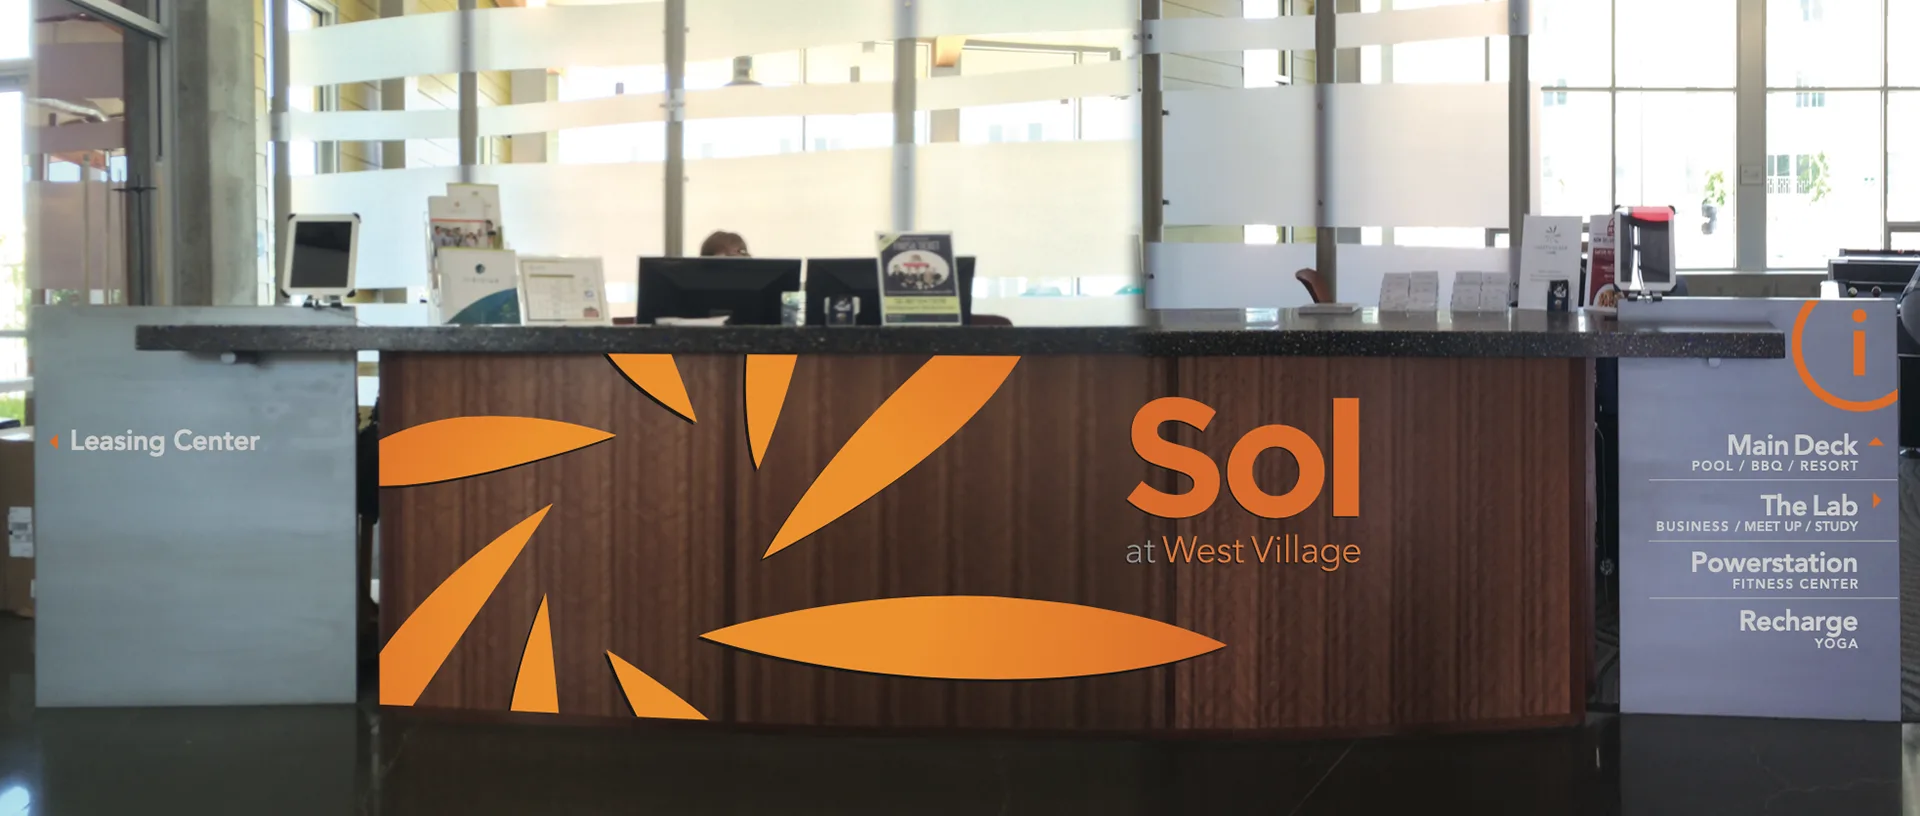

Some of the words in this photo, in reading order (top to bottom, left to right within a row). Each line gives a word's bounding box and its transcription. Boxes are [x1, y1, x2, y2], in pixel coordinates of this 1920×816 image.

[71, 429, 166, 457] Leasing
[174, 429, 261, 452] Center
[1728, 434, 1789, 455] Main
[1795, 433, 1859, 455] Deck
[1127, 397, 1360, 518] Sol
[1692, 460, 1734, 472] POOL
[1752, 460, 1783, 473] BBQ
[1801, 460, 1859, 472] RESORT
[1760, 493, 1808, 516] The
[1814, 493, 1859, 516] Lab
[1656, 520, 1729, 532] BUSINESS
[1745, 521, 1781, 532] MEET
[1785, 521, 1802, 532] UP
[1815, 521, 1859, 532] STUDY
[1126, 540, 1156, 564] at
[1162, 535, 1245, 564] West
[1251, 534, 1361, 572] Village
[1692, 551, 1858, 573] Powerstation
[1733, 578, 1794, 590] FITNESS
[1800, 578, 1859, 590] CENTER
[1740, 609, 1859, 638] Recharge
[1815, 638, 1859, 649] YOGA
